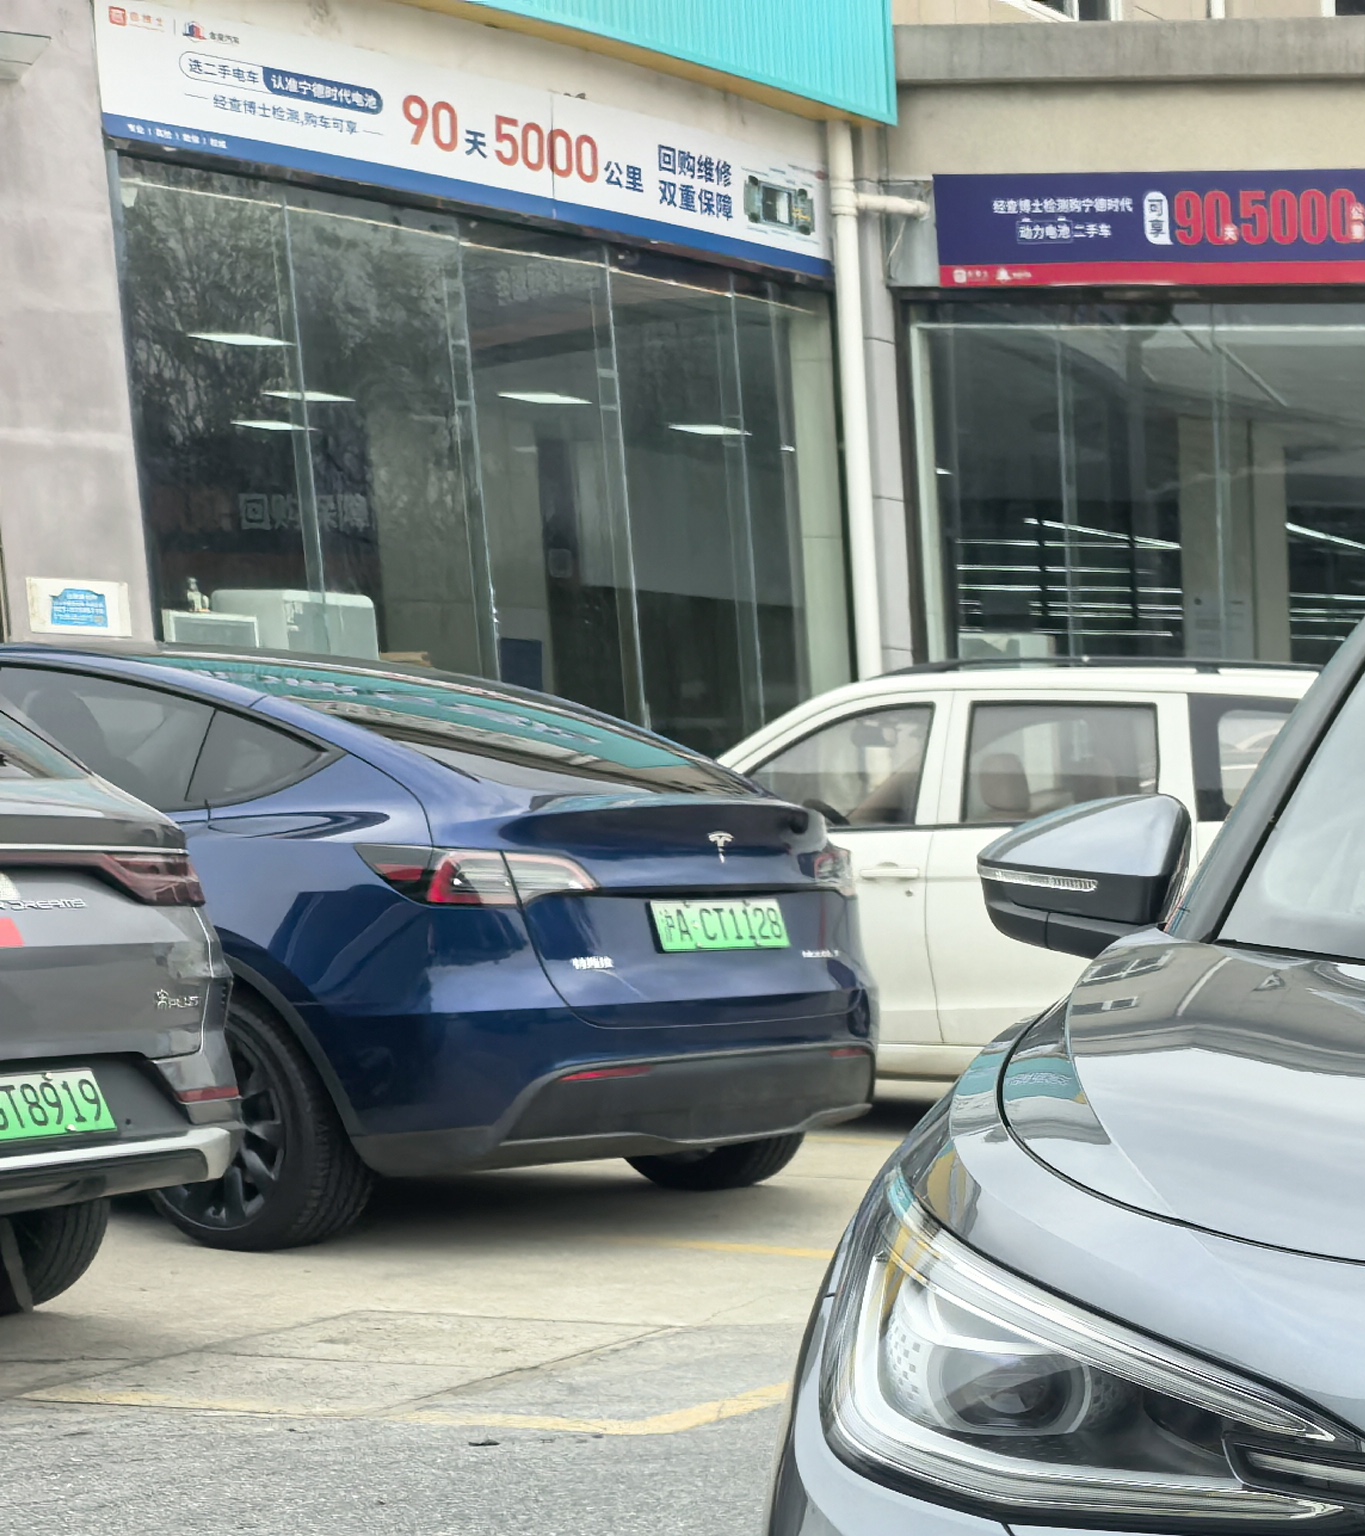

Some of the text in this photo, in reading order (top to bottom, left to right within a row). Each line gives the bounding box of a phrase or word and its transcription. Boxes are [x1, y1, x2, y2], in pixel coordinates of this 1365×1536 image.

[188, 57, 378, 110] 选二手电车 认准宁德时代电池
[657, 144, 732, 187] 回购维修
[658, 179, 733, 221] 双重保障
[1148, 198, 1166, 238] 可享
